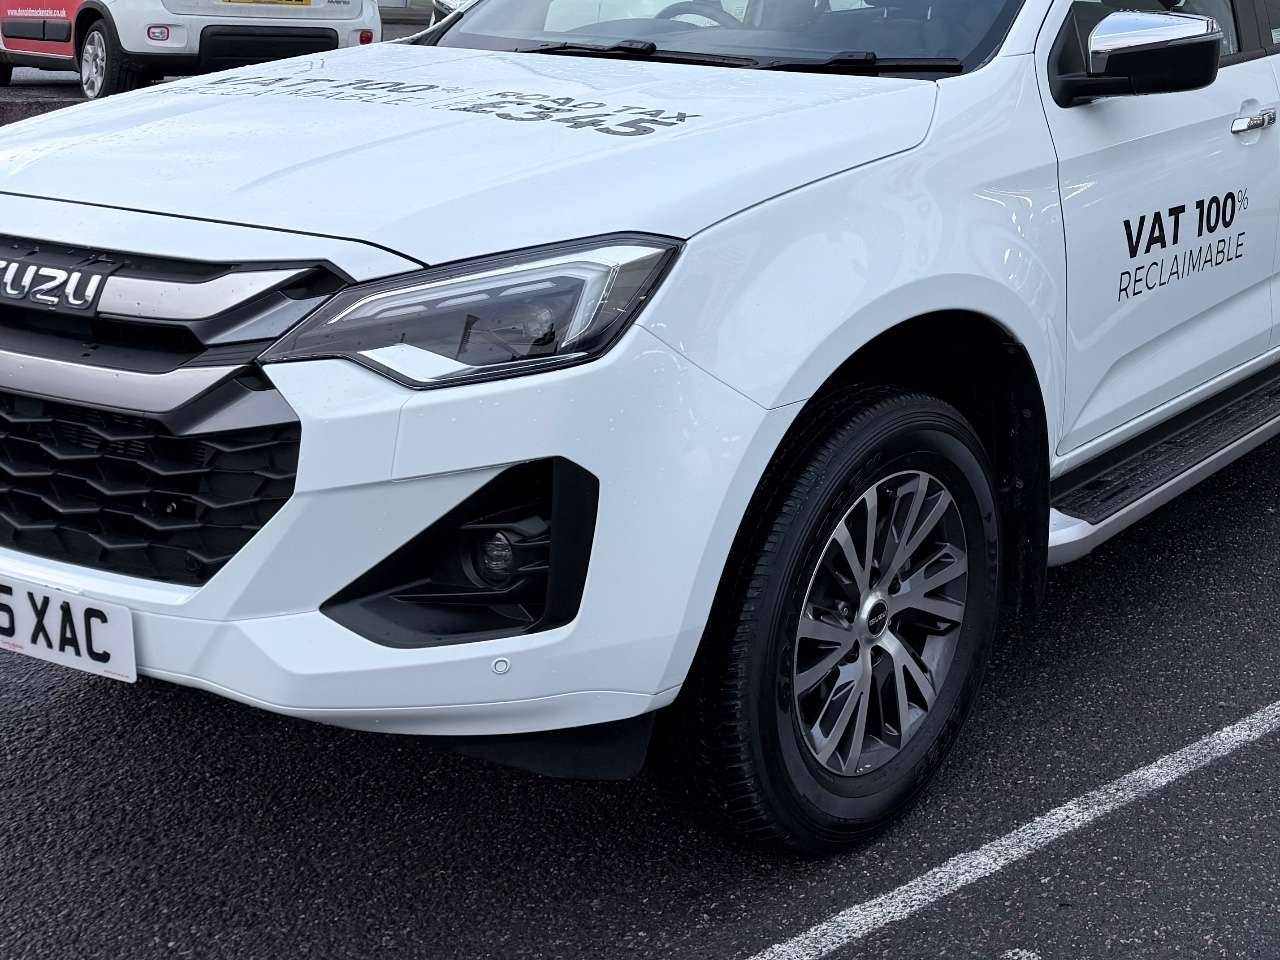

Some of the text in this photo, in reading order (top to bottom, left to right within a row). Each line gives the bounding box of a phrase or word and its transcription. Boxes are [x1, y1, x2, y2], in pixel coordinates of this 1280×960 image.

[487, 91, 606, 109] ROAD
[614, 105, 703, 123] TAX
[1123, 204, 1186, 259] VAT
[0, 261, 102, 309] UZU
[1117, 231, 1246, 302] RECLAIMABLE
[27, 591, 111, 664] XAC
